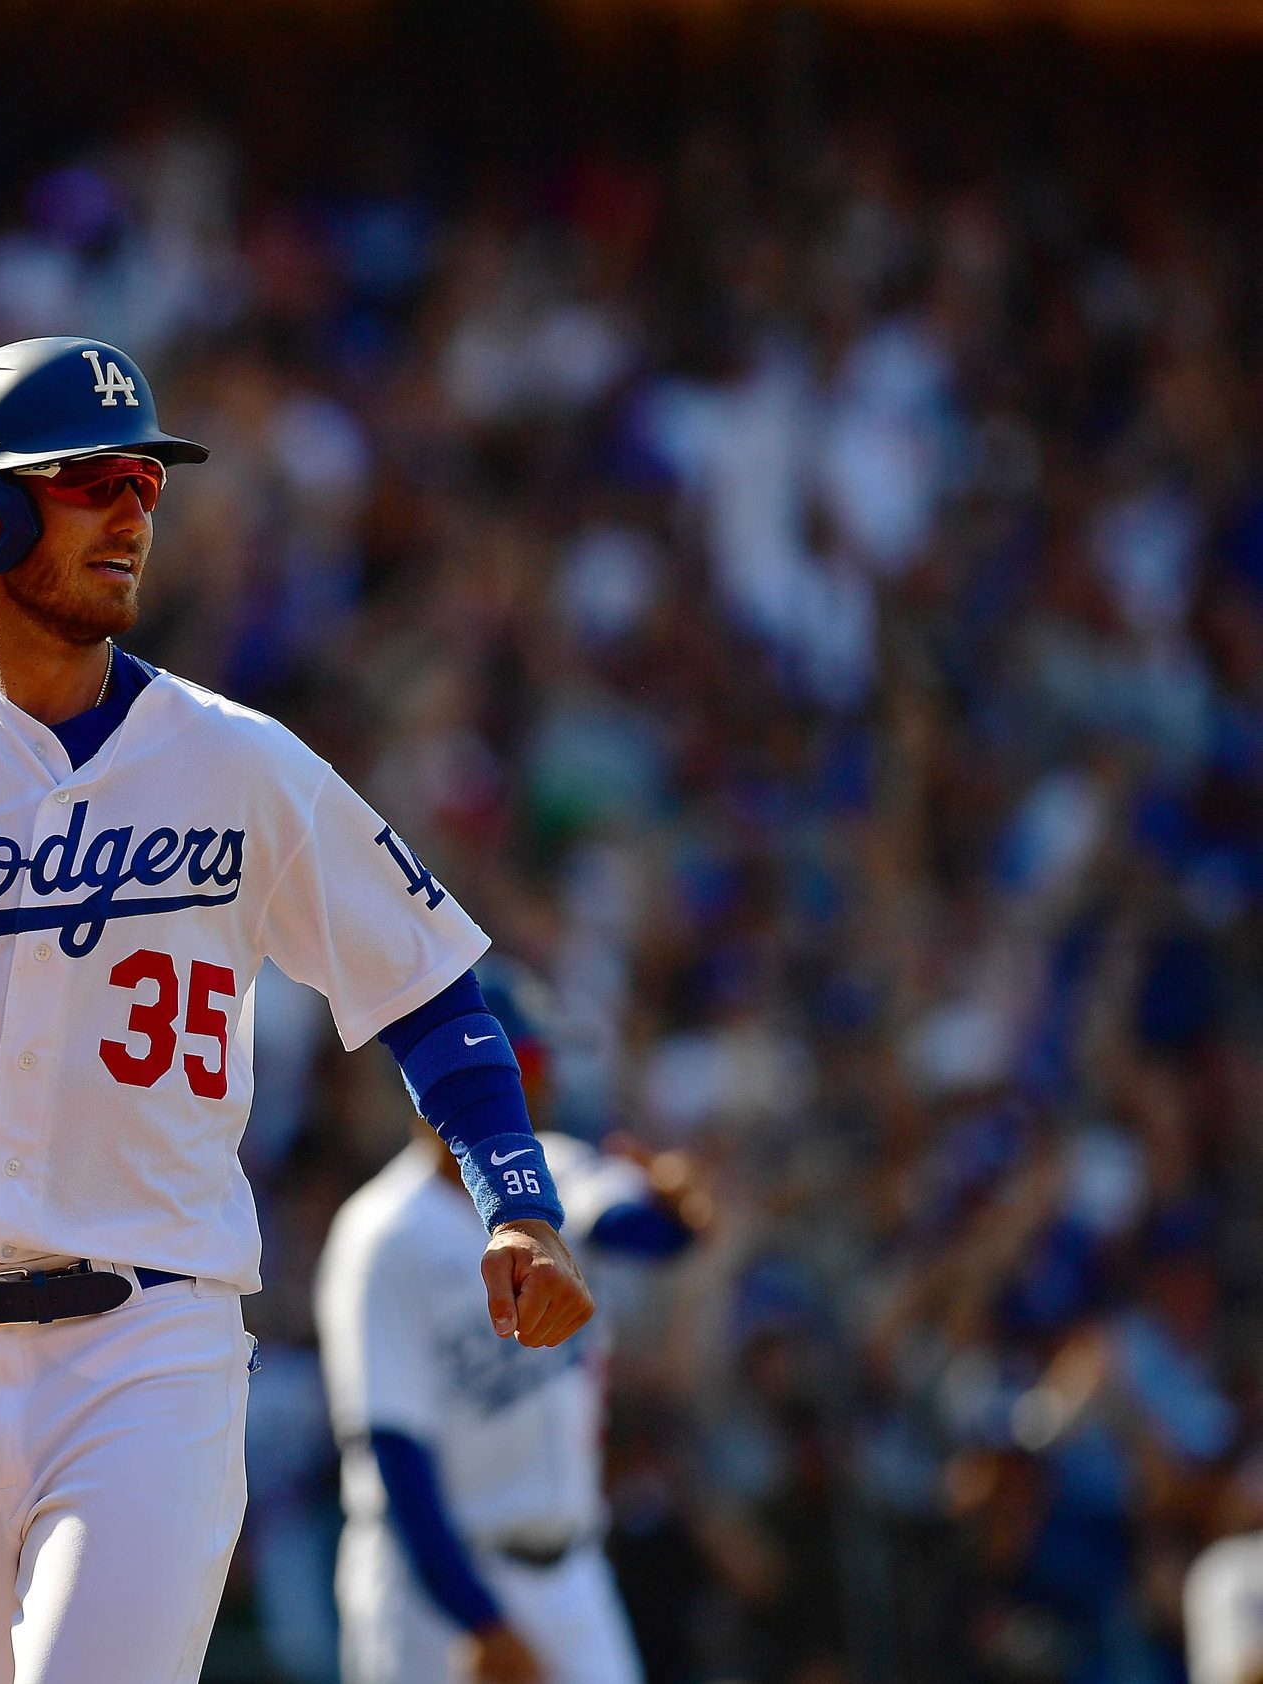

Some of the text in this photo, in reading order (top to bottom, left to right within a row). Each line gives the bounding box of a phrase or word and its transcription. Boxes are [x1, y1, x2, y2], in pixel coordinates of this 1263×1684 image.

[82, 351, 139, 407] LA
[99, 949, 236, 1100] 35
[503, 1169, 541, 1195] 35
